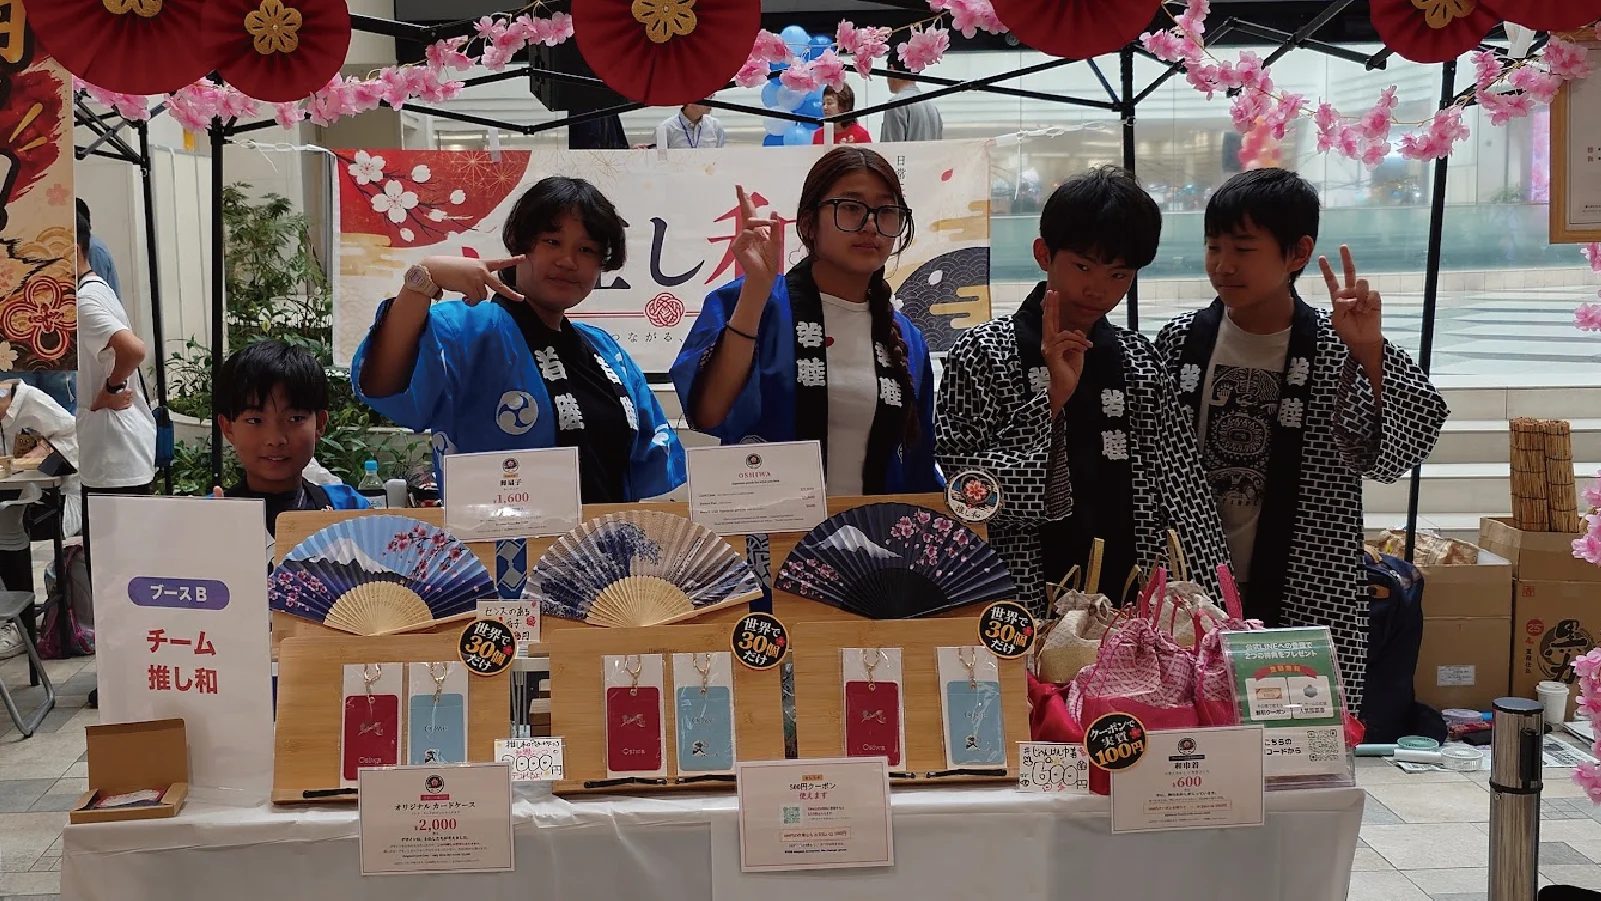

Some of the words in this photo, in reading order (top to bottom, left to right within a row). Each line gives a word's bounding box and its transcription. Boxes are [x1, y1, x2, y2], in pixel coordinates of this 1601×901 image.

[990, 606, 1029, 627] 世界で
[473, 621, 511, 645] 世界で
[743, 617, 781, 638] 世界で
[984, 620, 1028, 648] 30個
[146, 628, 217, 656] チーム
[465, 634, 506, 665] 30個
[738, 631, 780, 659] 30個
[990, 638, 1015, 655] だけ
[467, 653, 492, 671] だけ
[742, 649, 768, 665] だけ
[148, 664, 218, 694] 推し和
[1089, 720, 1136, 741] クーポンで
[1101, 731, 1129, 748] 実質
[1095, 740, 1144, 765] 100円
[1264, 738, 1292, 746] こちらの
[799, 791, 828, 801] 使えます
